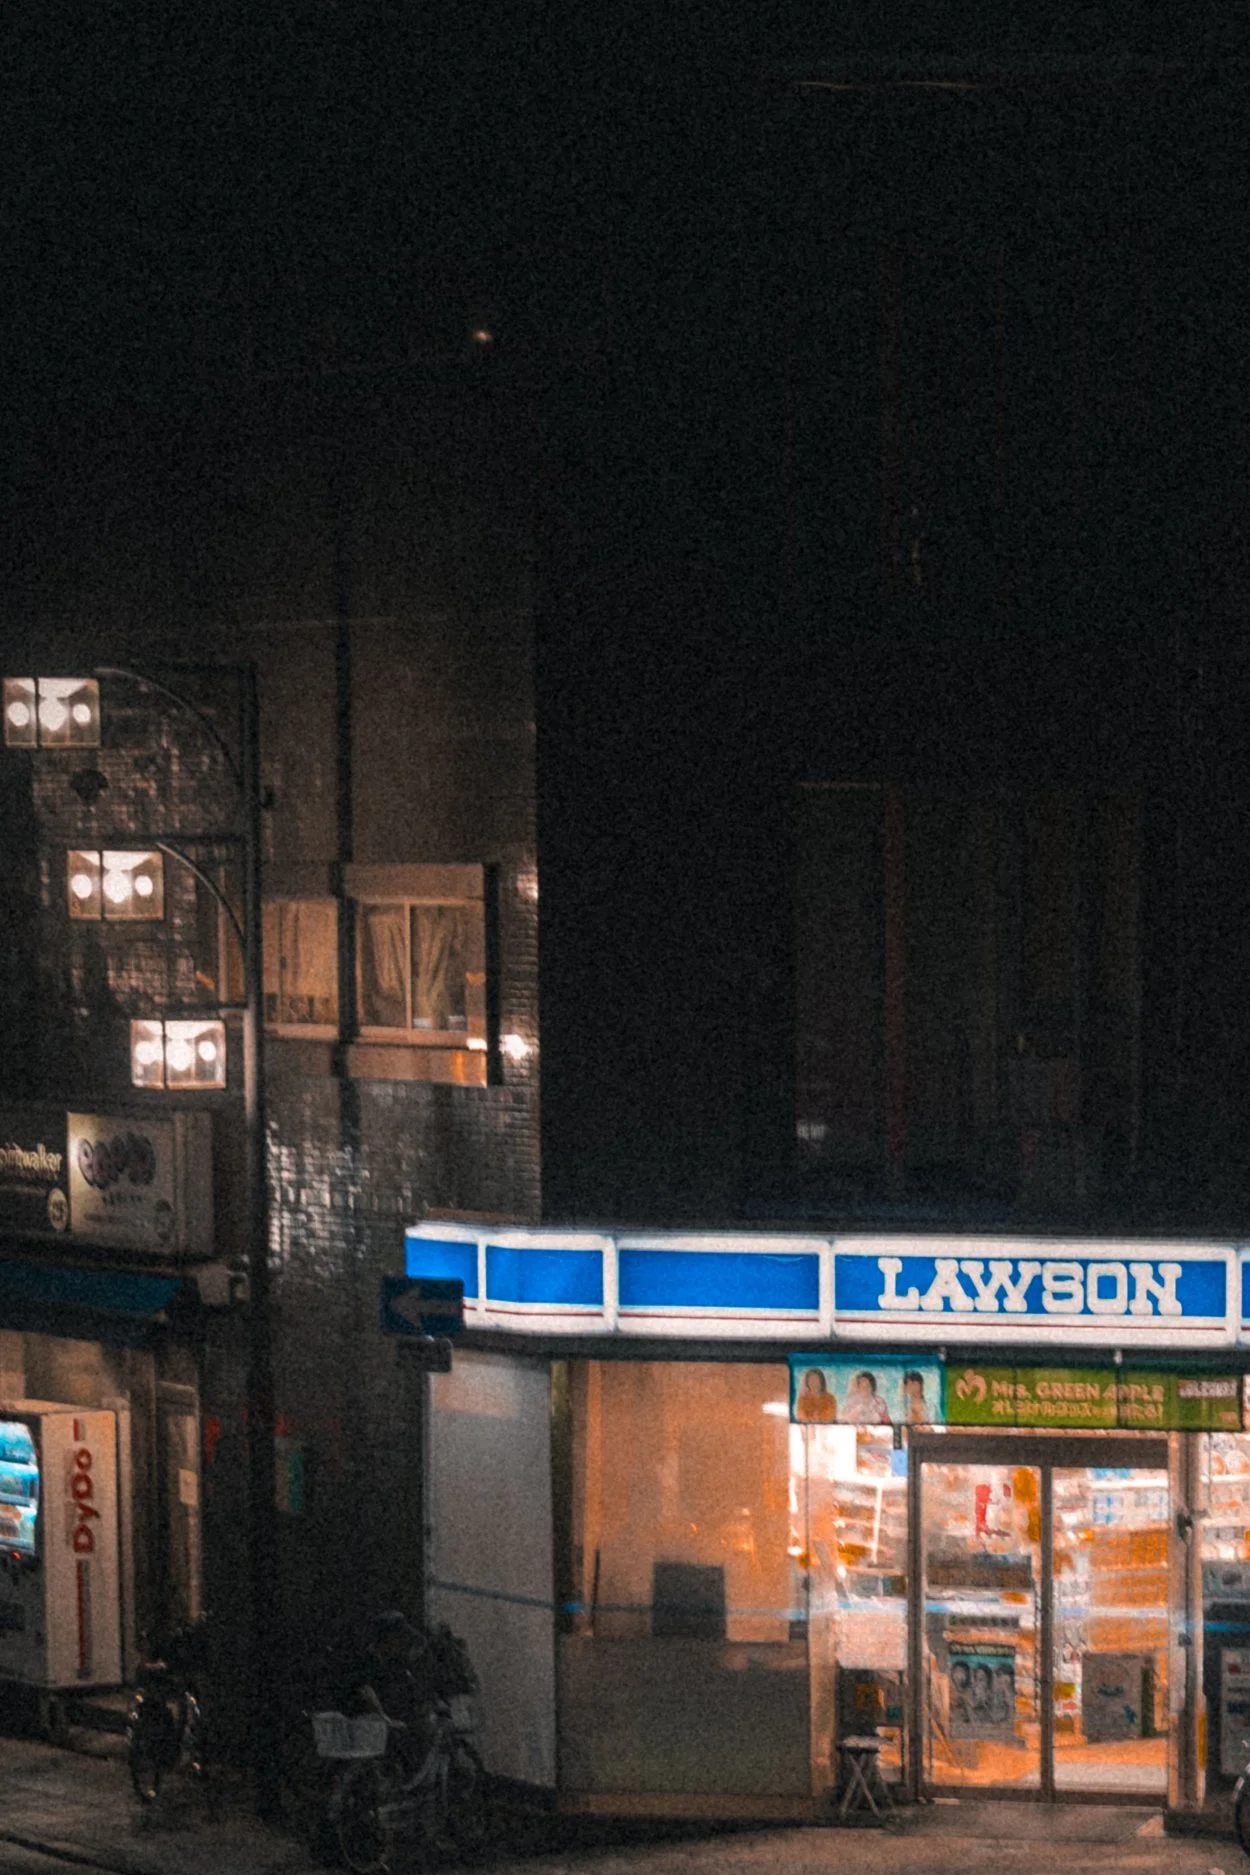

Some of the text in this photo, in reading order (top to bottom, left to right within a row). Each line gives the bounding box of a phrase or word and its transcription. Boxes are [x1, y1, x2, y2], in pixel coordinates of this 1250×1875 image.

[878, 1257, 1183, 1316] LAWSON
[1035, 1381, 1100, 1400] GREEN
[1103, 1384, 1164, 1403] APPLE
[72, 1448, 99, 1553] DyDo
